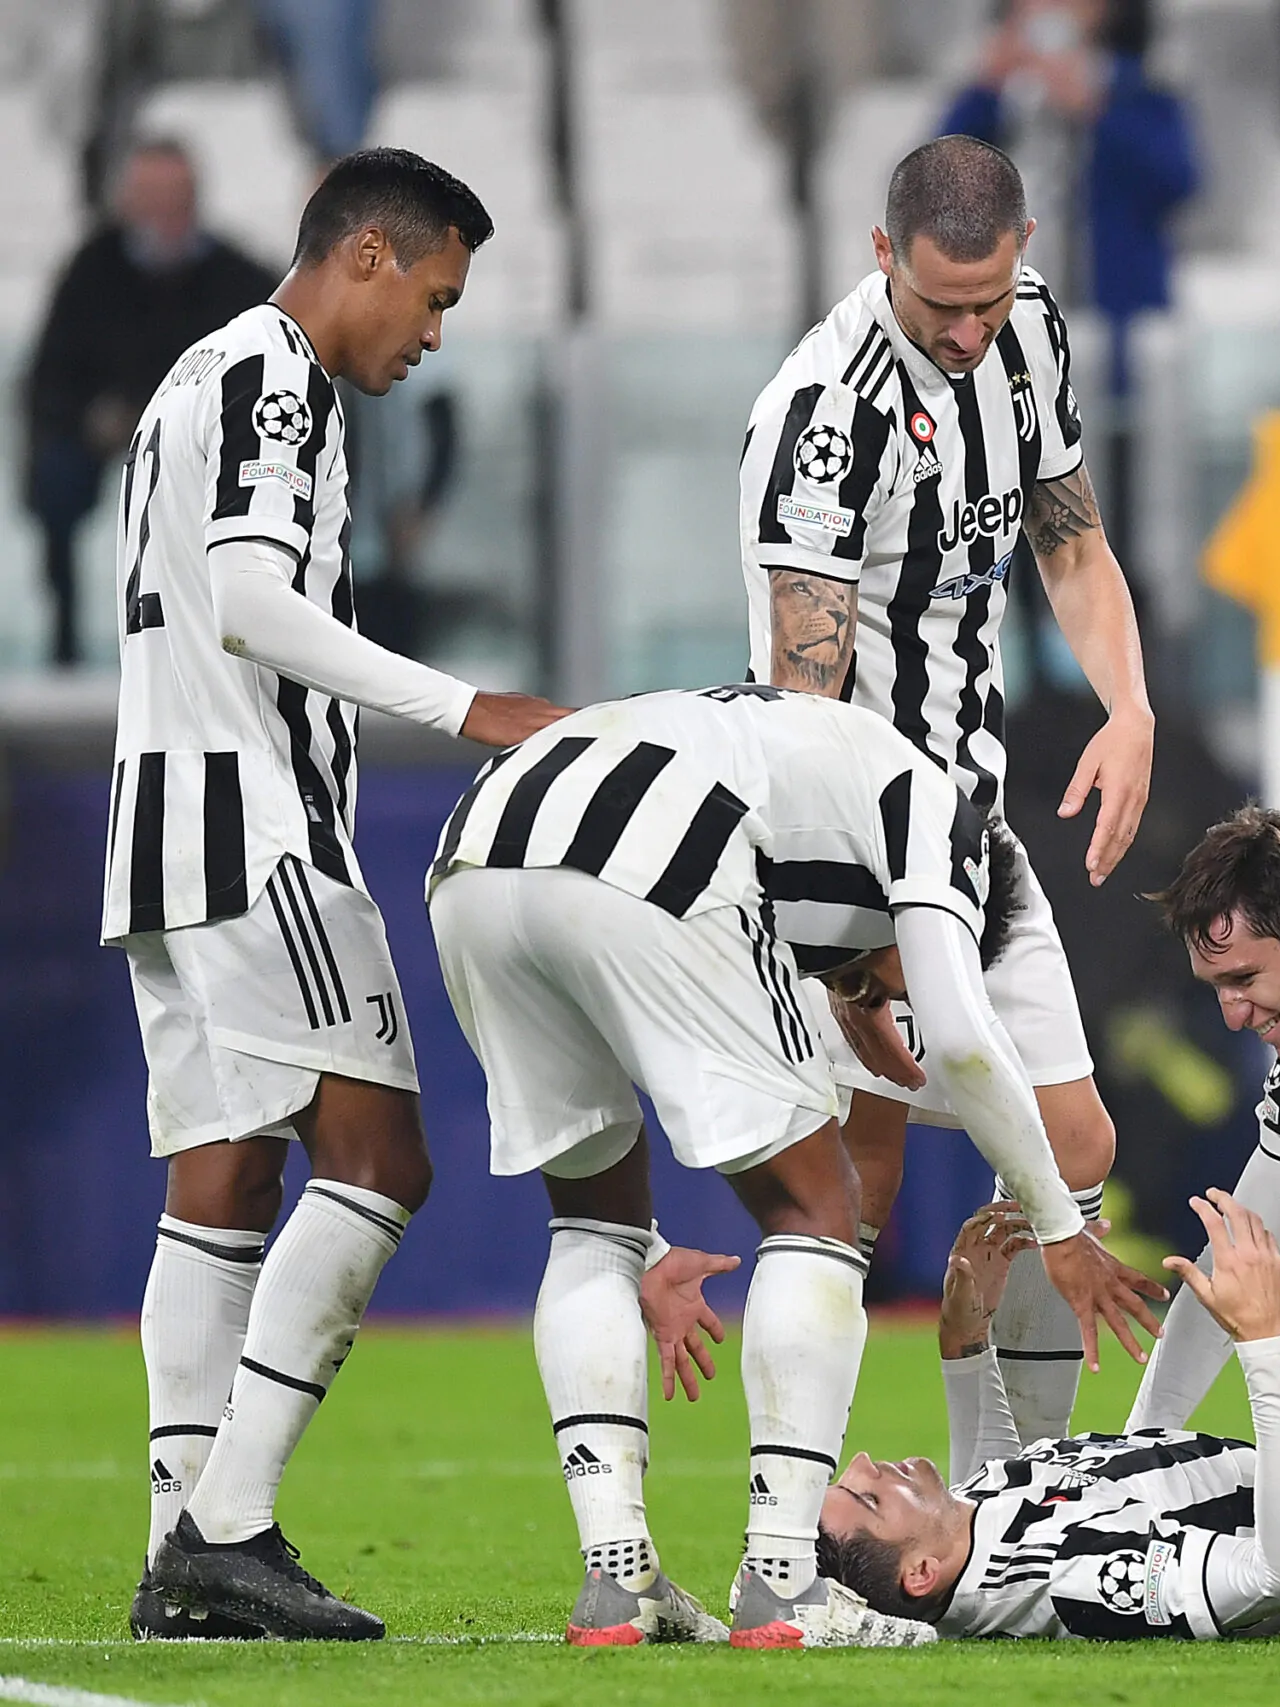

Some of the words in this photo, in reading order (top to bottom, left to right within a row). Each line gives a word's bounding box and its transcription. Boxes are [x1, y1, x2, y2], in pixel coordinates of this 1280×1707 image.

[241, 465, 311, 492] FOUNDATION
[914, 461, 943, 483] adidas
[779, 503, 851, 528] FOUNDATION
[938, 486, 1023, 554] Jeep
